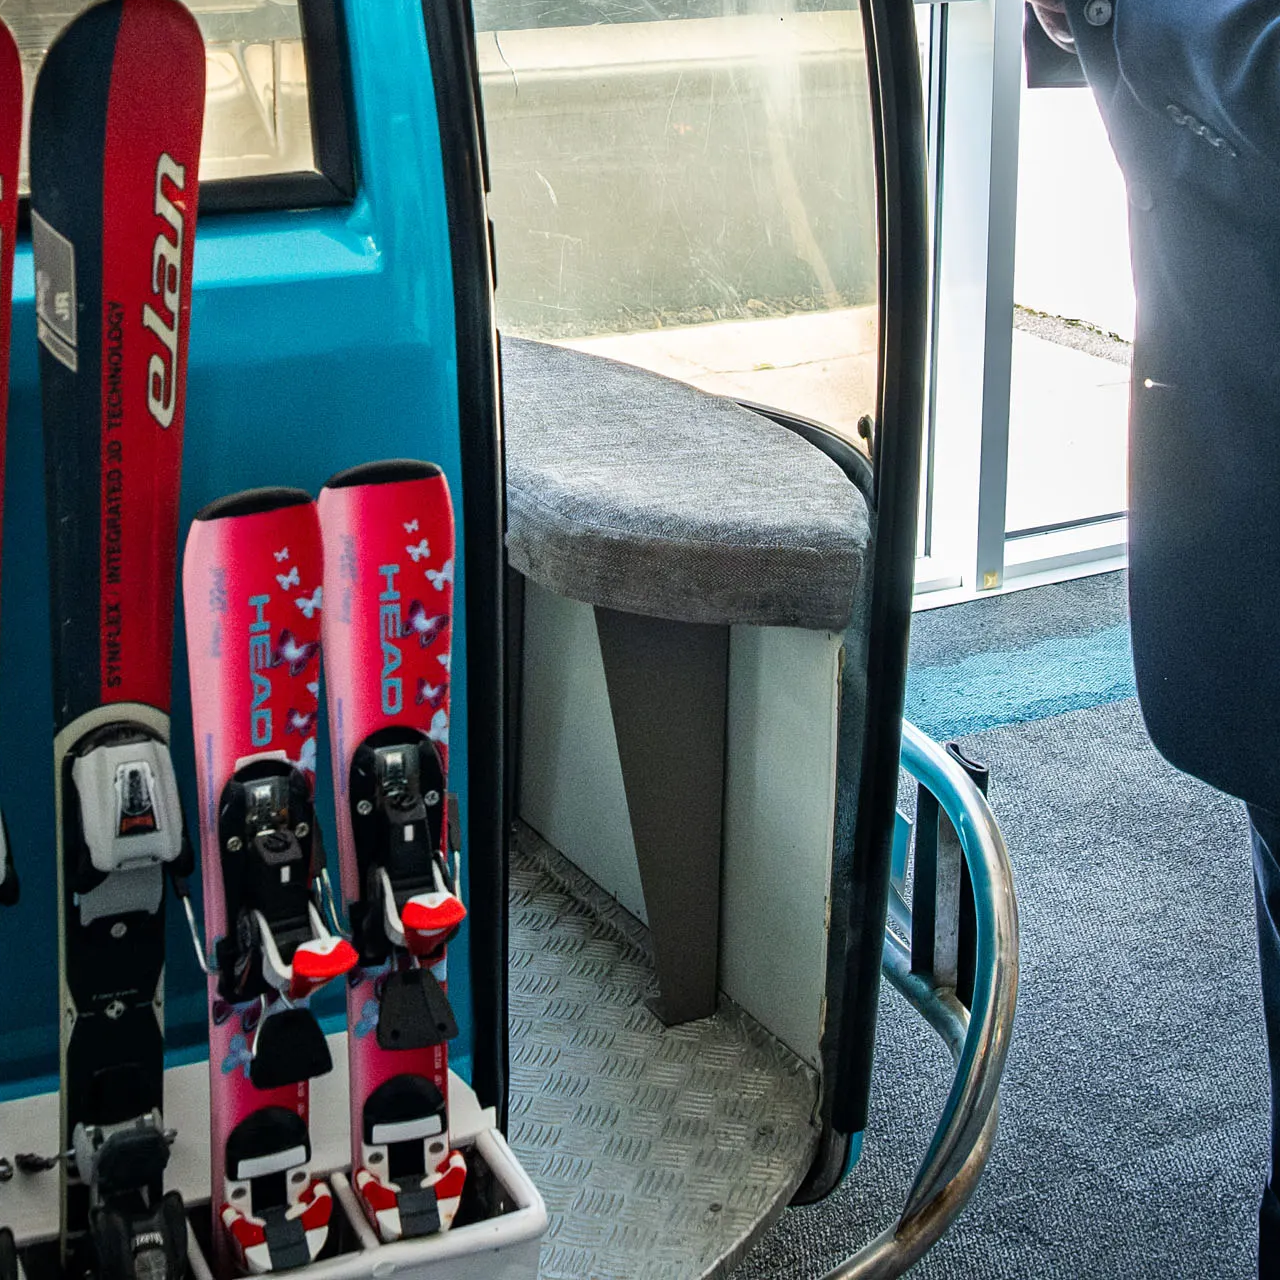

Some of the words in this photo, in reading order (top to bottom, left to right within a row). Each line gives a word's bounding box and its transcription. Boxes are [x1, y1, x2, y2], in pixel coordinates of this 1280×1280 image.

[53, 291, 70, 321] JR
[142, 151, 187, 429] elan
[106, 300, 125, 431] TECHNOLOGY
[106, 469, 123, 585] INTEGRATED
[106, 602, 122, 688] SYNFLEX
[248, 593, 273, 748] HEAD
[377, 563, 404, 716] HEAD
